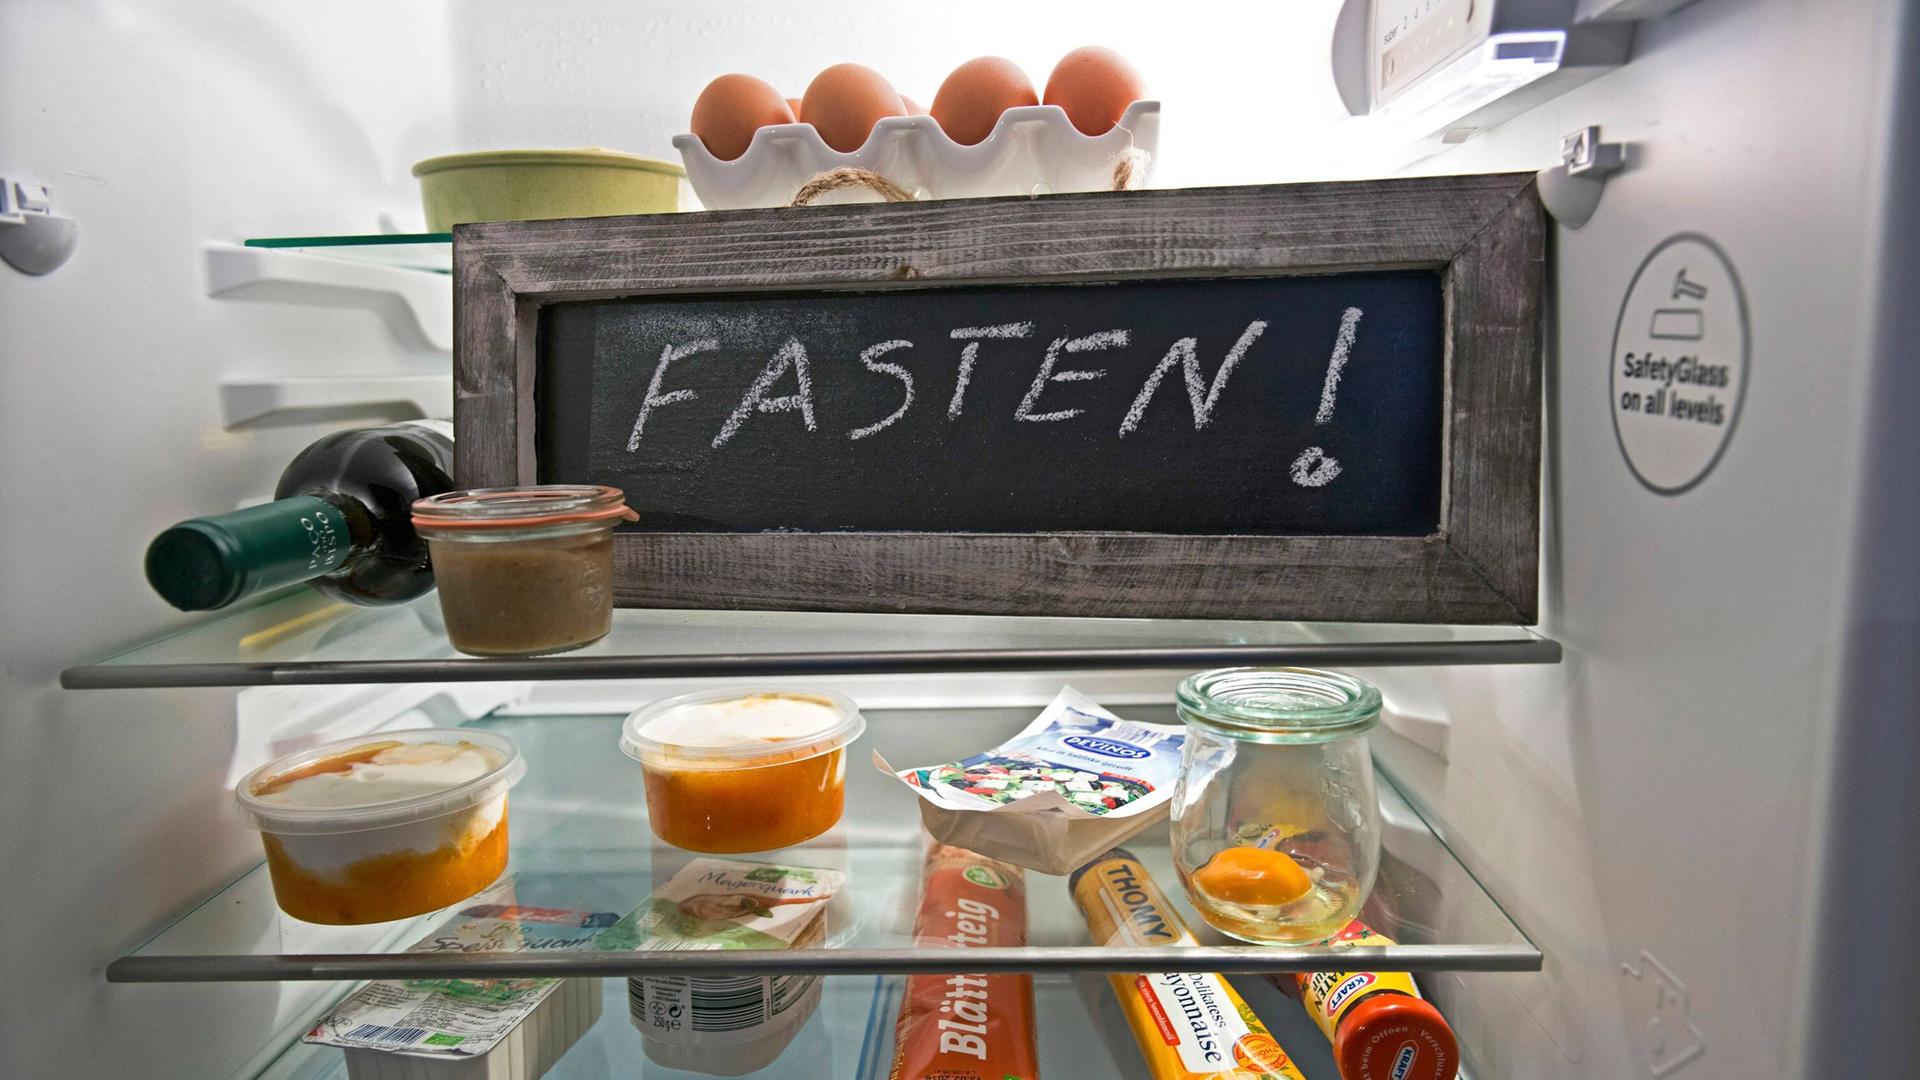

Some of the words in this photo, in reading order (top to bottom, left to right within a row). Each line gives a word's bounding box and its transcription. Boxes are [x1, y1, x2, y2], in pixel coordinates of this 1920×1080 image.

[1623, 353, 1730, 388] SafetyGlass
[1620, 391, 1641, 411] on
[1645, 389, 1667, 416] all
[1669, 391, 1726, 427] levels
[1067, 737, 1147, 758] DEVINOS
[698, 871, 815, 897] Magerquark
[1107, 864, 1173, 938] THOMY
[938, 898, 1000, 1061] Blättteig
[1314, 971, 1345, 1012] ATEN
[1331, 977, 1365, 1009] KRAFT
[1160, 972, 1222, 1063] ayonnaise
[1188, 972, 1226, 1028] Delikatess
[1394, 1048, 1414, 1080] KRAFT
